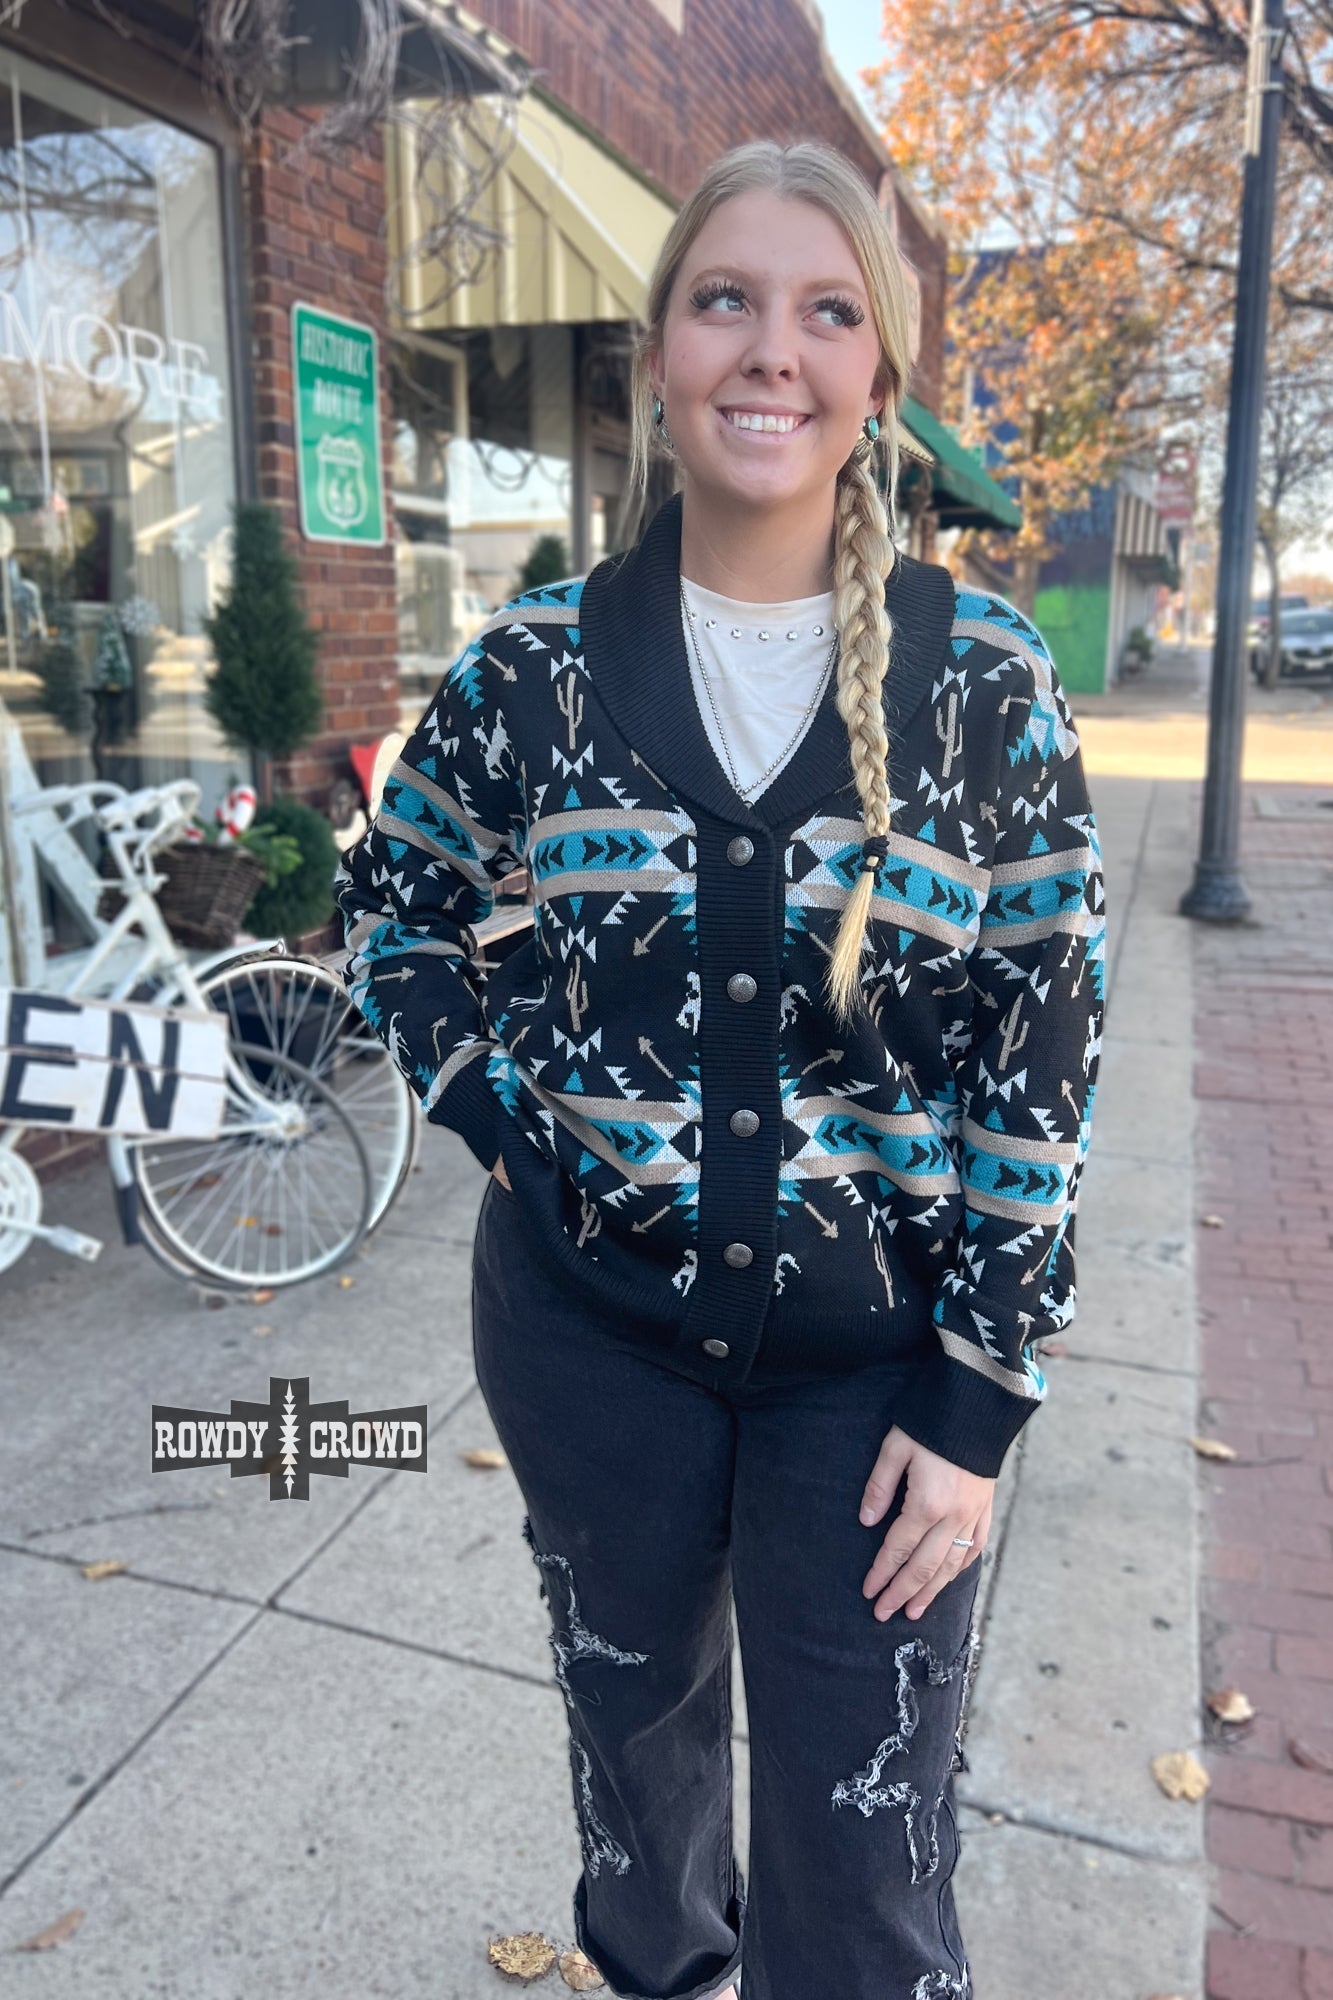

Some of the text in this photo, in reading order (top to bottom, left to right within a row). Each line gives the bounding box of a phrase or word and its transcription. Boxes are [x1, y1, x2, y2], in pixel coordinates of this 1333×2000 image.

[0, 288, 210, 404] MORE
[301, 321, 370, 379] HISTORIC
[313, 377, 362, 425] ROUTE
[327, 479, 358, 516] 66
[0, 992, 181, 1131] EN
